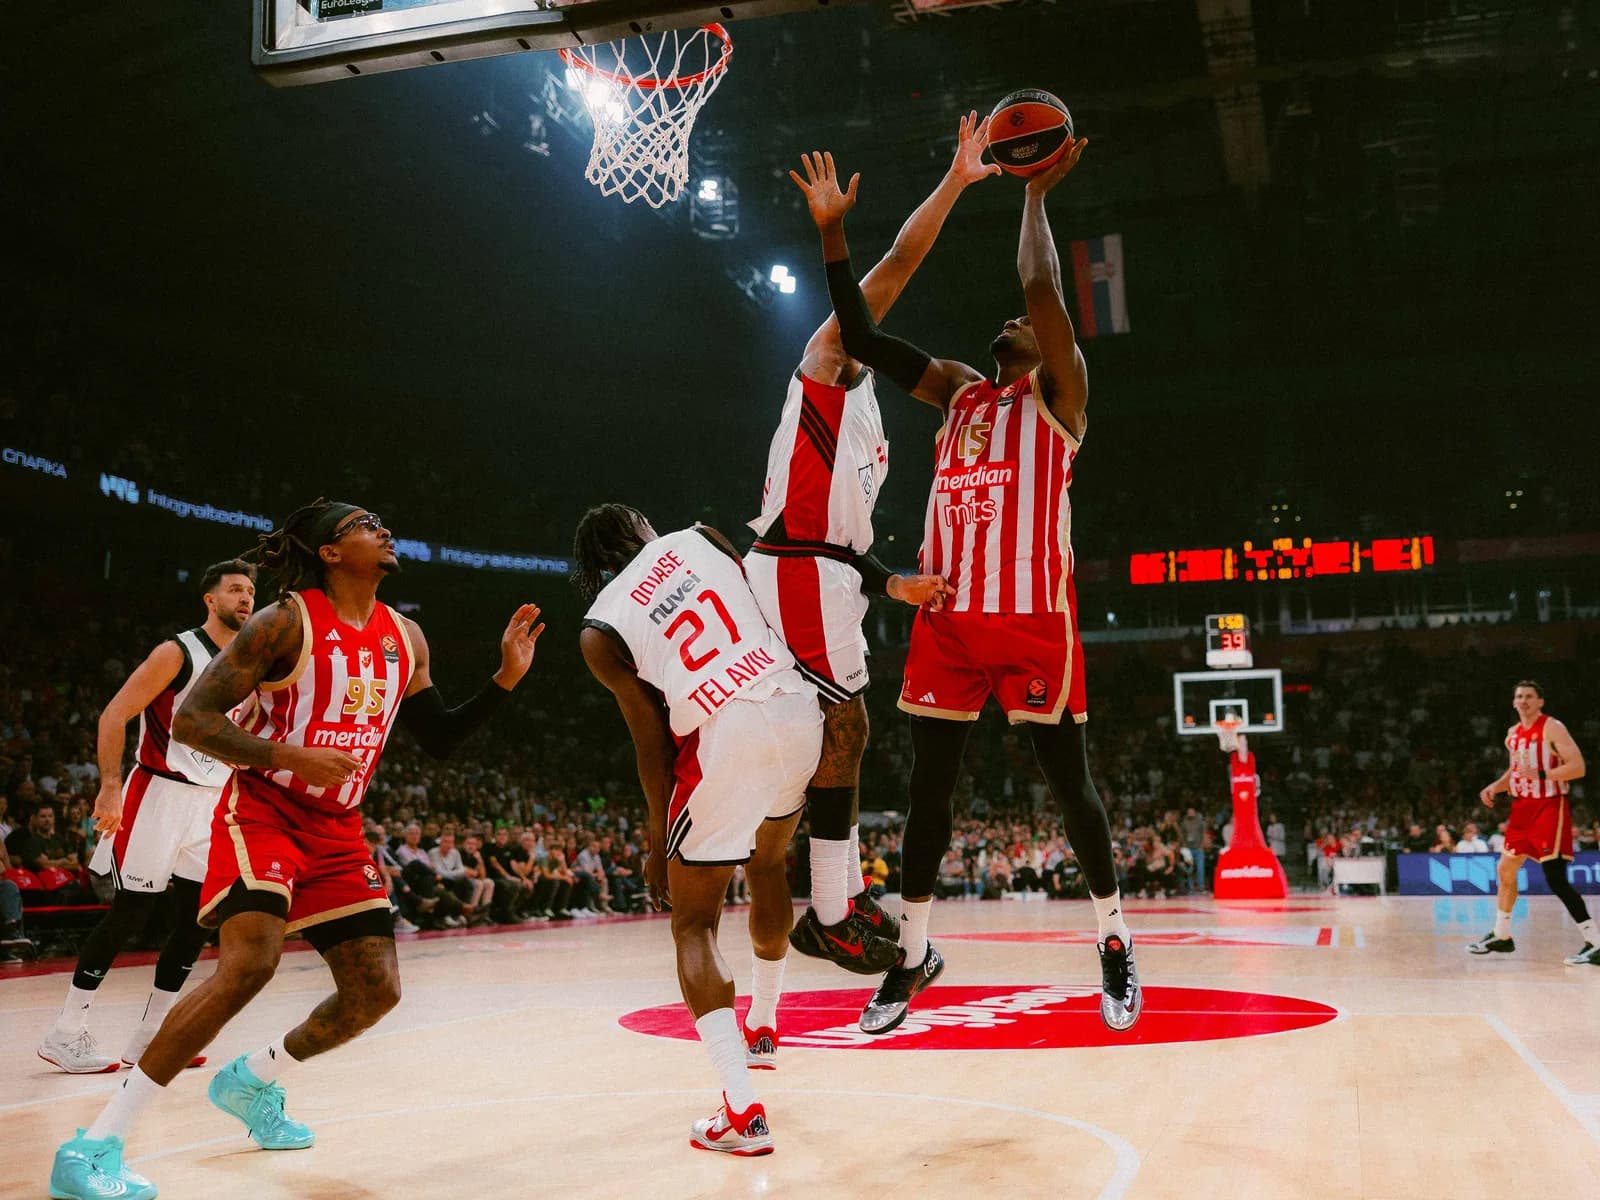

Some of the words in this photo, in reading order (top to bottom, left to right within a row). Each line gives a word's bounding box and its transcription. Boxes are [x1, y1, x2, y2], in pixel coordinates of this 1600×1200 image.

[321, 0, 377, 9] EuroLeag
[957, 422, 991, 459] 15
[936, 466, 1013, 491] meridian
[944, 496, 999, 527] mts
[630, 550, 685, 607] ODIASE
[649, 569, 702, 625] nuvei
[664, 589, 742, 672] 21
[343, 676, 387, 718] 95
[688, 677, 736, 716] TEL
[725, 647, 776, 689] AVIV
[312, 727, 383, 747] meridi
